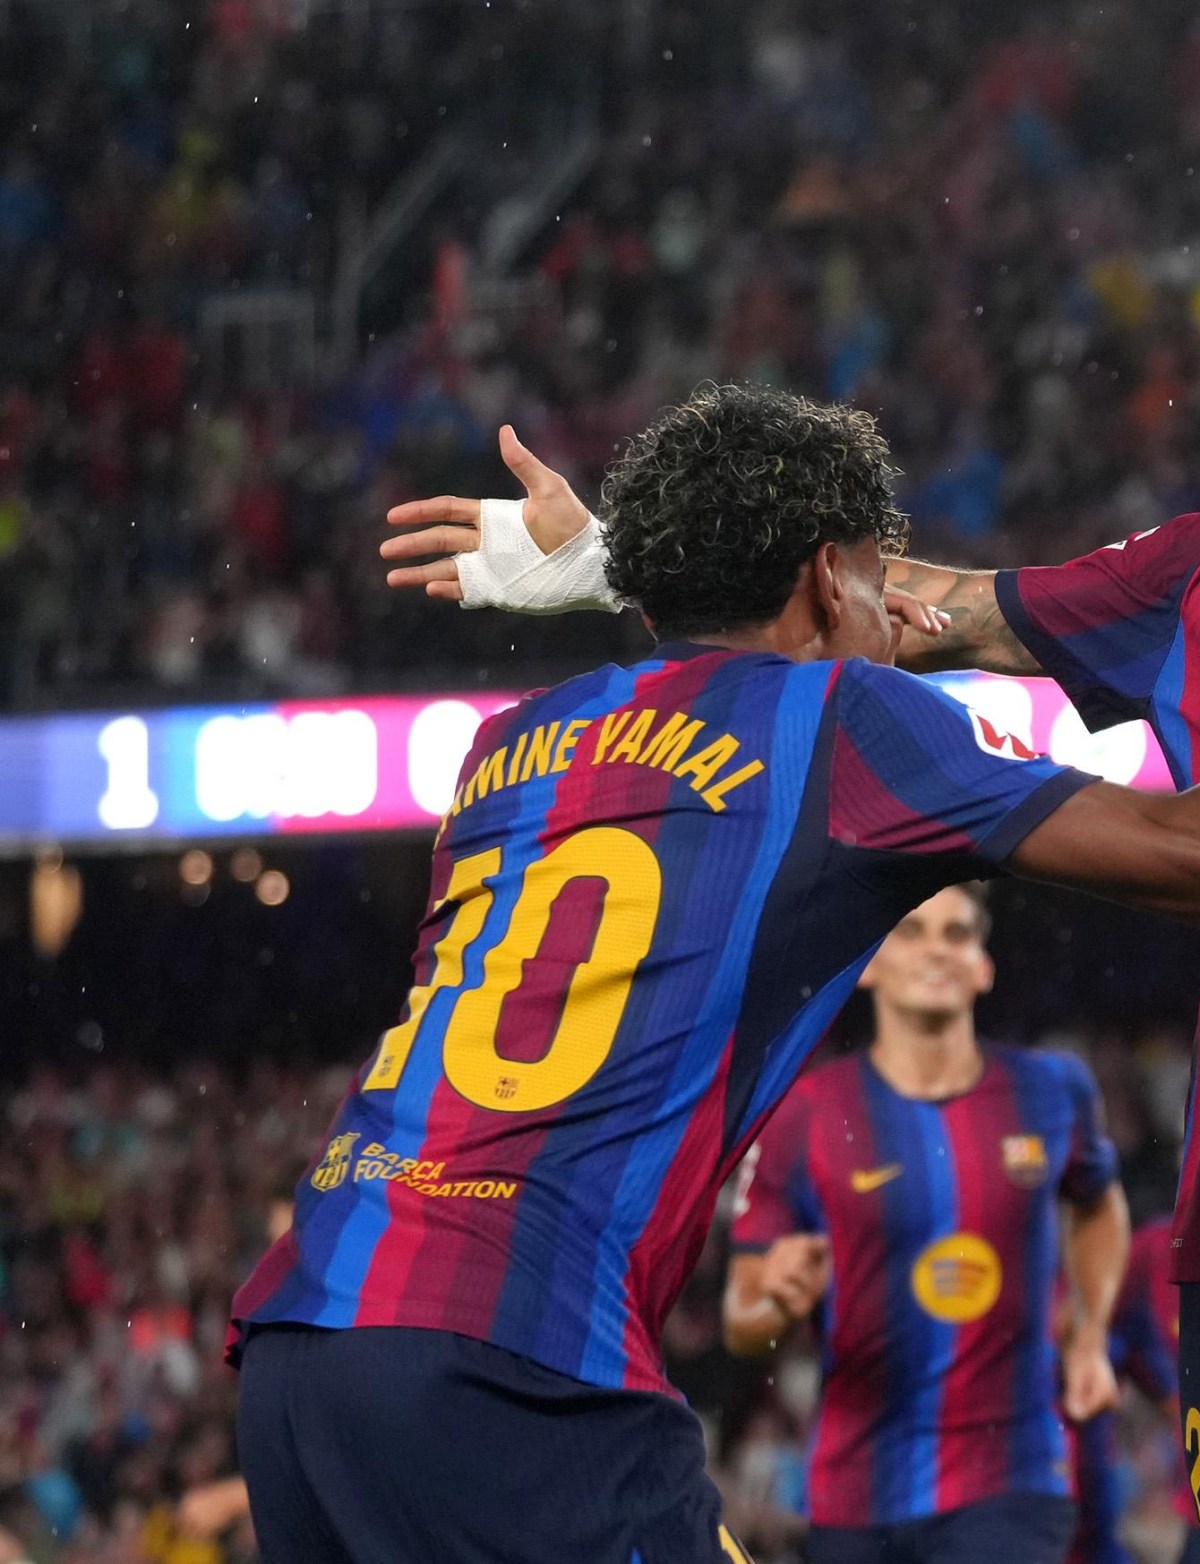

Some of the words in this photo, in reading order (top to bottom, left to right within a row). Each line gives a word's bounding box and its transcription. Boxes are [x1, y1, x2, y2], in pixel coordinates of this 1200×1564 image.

[433, 718, 593, 852] AMINE
[591, 708, 766, 814] YAMAL
[362, 826, 662, 1113] 10
[353, 1159, 518, 1199] FOUNDATION
